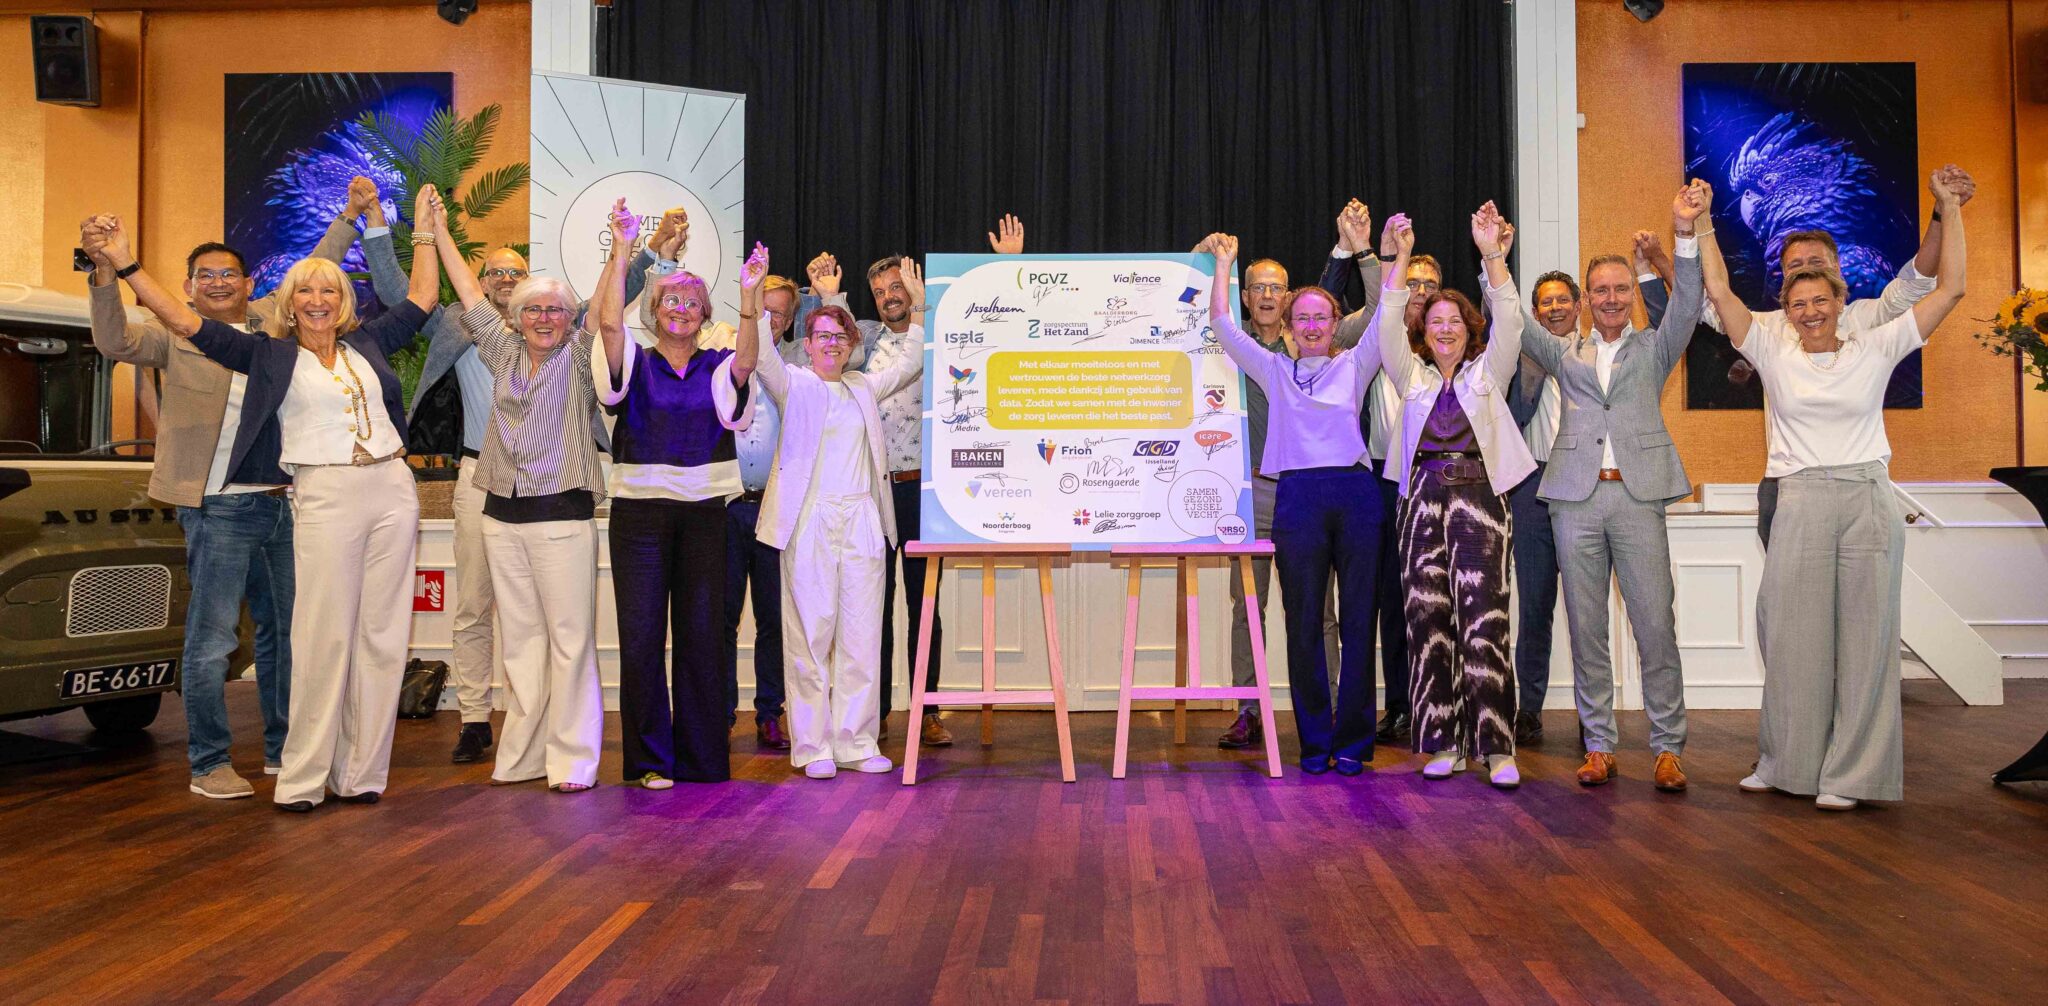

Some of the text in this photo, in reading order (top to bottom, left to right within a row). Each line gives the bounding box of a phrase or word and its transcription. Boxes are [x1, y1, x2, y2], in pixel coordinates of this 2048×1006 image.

[1029, 273, 1069, 284] PGVZ
[1044, 321, 1088, 329] zorgspectrum
[1044, 328, 1089, 336] Het Zand
[1019, 360, 1160, 369] Met elkaar moeiteloos en met
[1009, 374, 1170, 383] vertrouwen de beste netwerkzorg
[1038, 386, 1066, 396] mede
[1069, 386, 1102, 396] dankzij
[1104, 386, 1124, 396] slim
[1127, 386, 1163, 396] gebruik
[1165, 386, 1182, 396] van
[999, 399, 1182, 408] data. Zodat we samen met de inwoner
[1008, 412, 1173, 421] de zorg leveren die het beste past.
[954, 424, 981, 432] Medrie
[1061, 446, 1092, 455] Frion
[1135, 441, 1177, 455] GGD
[960, 451, 1002, 461] BAKEN
[1082, 478, 1140, 488] Rosengaerde
[984, 487, 1032, 498] vereen
[1186, 488, 1218, 496] SAMEN
[1183, 495, 1222, 503] GEZOND
[1184, 503, 1222, 511] IJSSEL
[42, 509, 177, 524] AUSTI
[1094, 510, 1161, 520] Lelie zorggroep
[982, 522, 1031, 530] Noorderboog
[71, 663, 170, 695] BE-66-17
